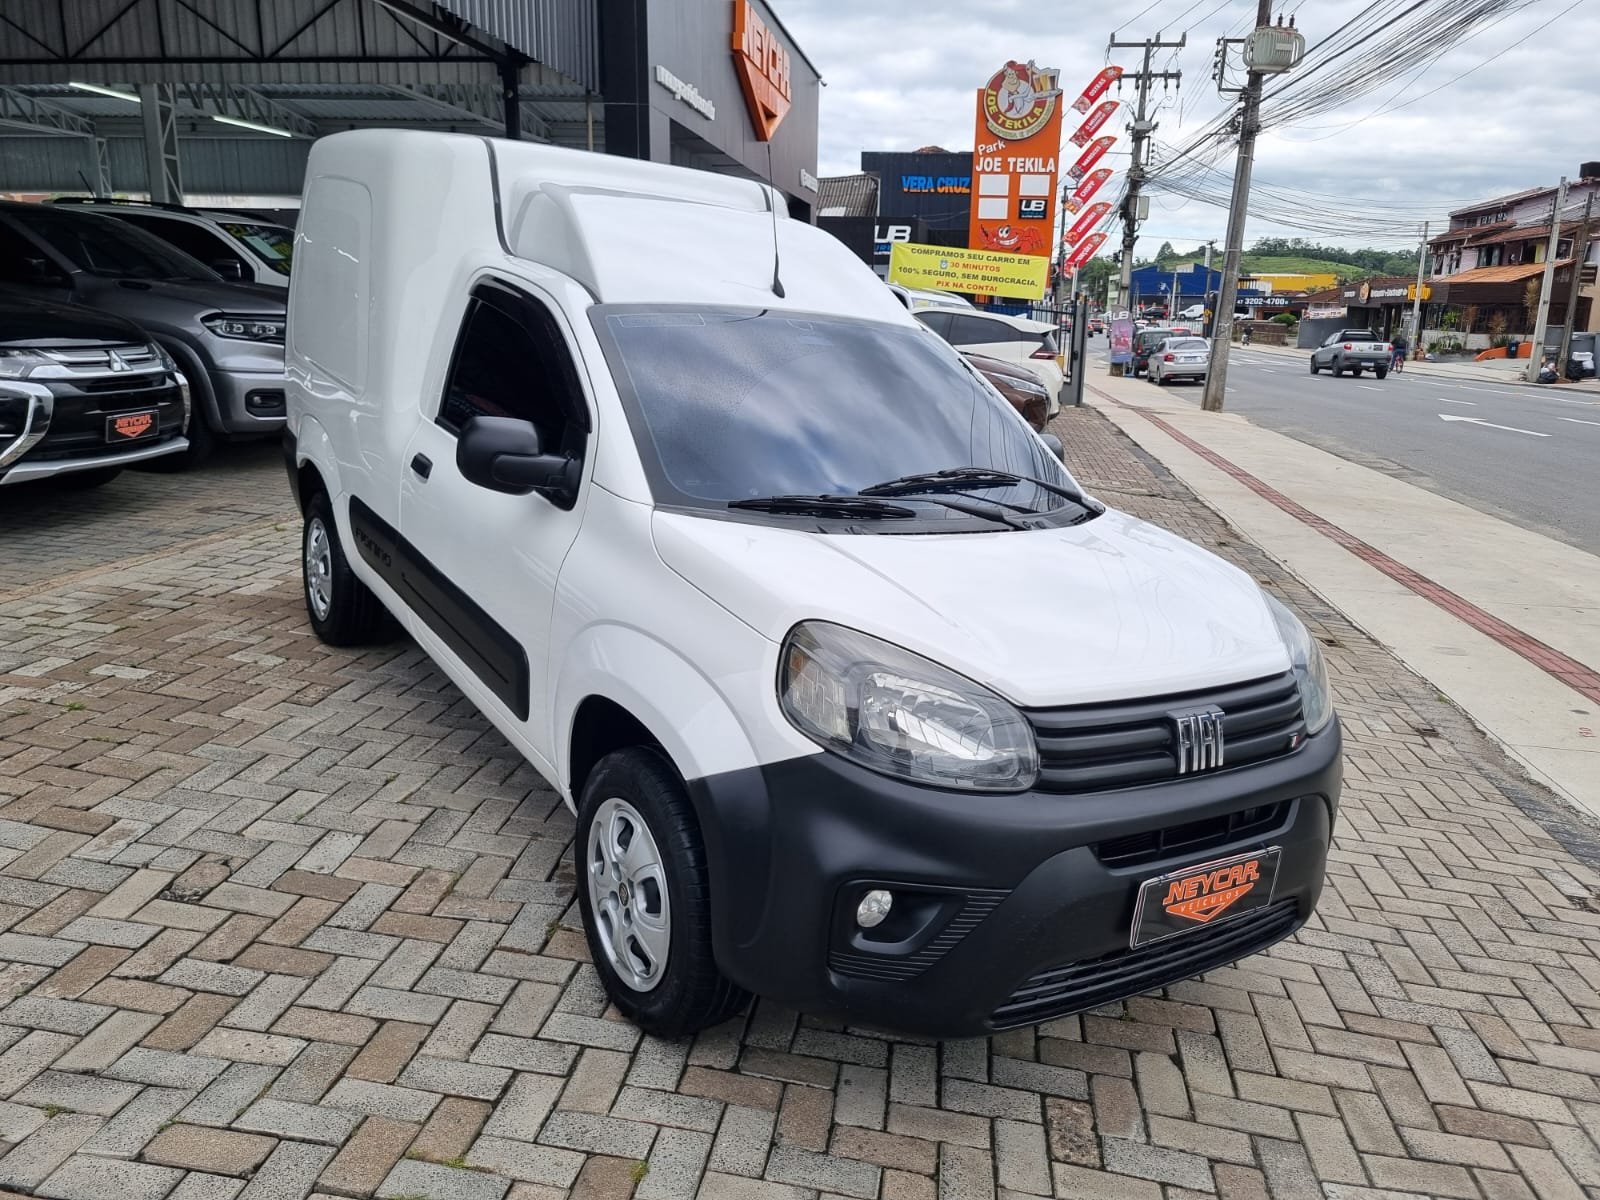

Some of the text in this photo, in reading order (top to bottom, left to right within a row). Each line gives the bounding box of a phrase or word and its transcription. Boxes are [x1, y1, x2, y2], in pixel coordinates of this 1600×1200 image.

[986, 88, 1043, 129] JOE TEKILA
[977, 140, 1006, 155] Park
[975, 157, 1056, 173] JOE TEKILA
[901, 175, 970, 194] VERA CRUZ
[911, 247, 1030, 266] COMPRAMOS SEU CARRO EM
[898, 266, 920, 275] 100%
[961, 272, 979, 281] SEM
[950, 261, 1001, 273] 30 MINUTOS
[936, 280, 950, 288] PIX
[1177, 711, 1225, 774] FIAT
[1163, 860, 1260, 906] NEYCAR
